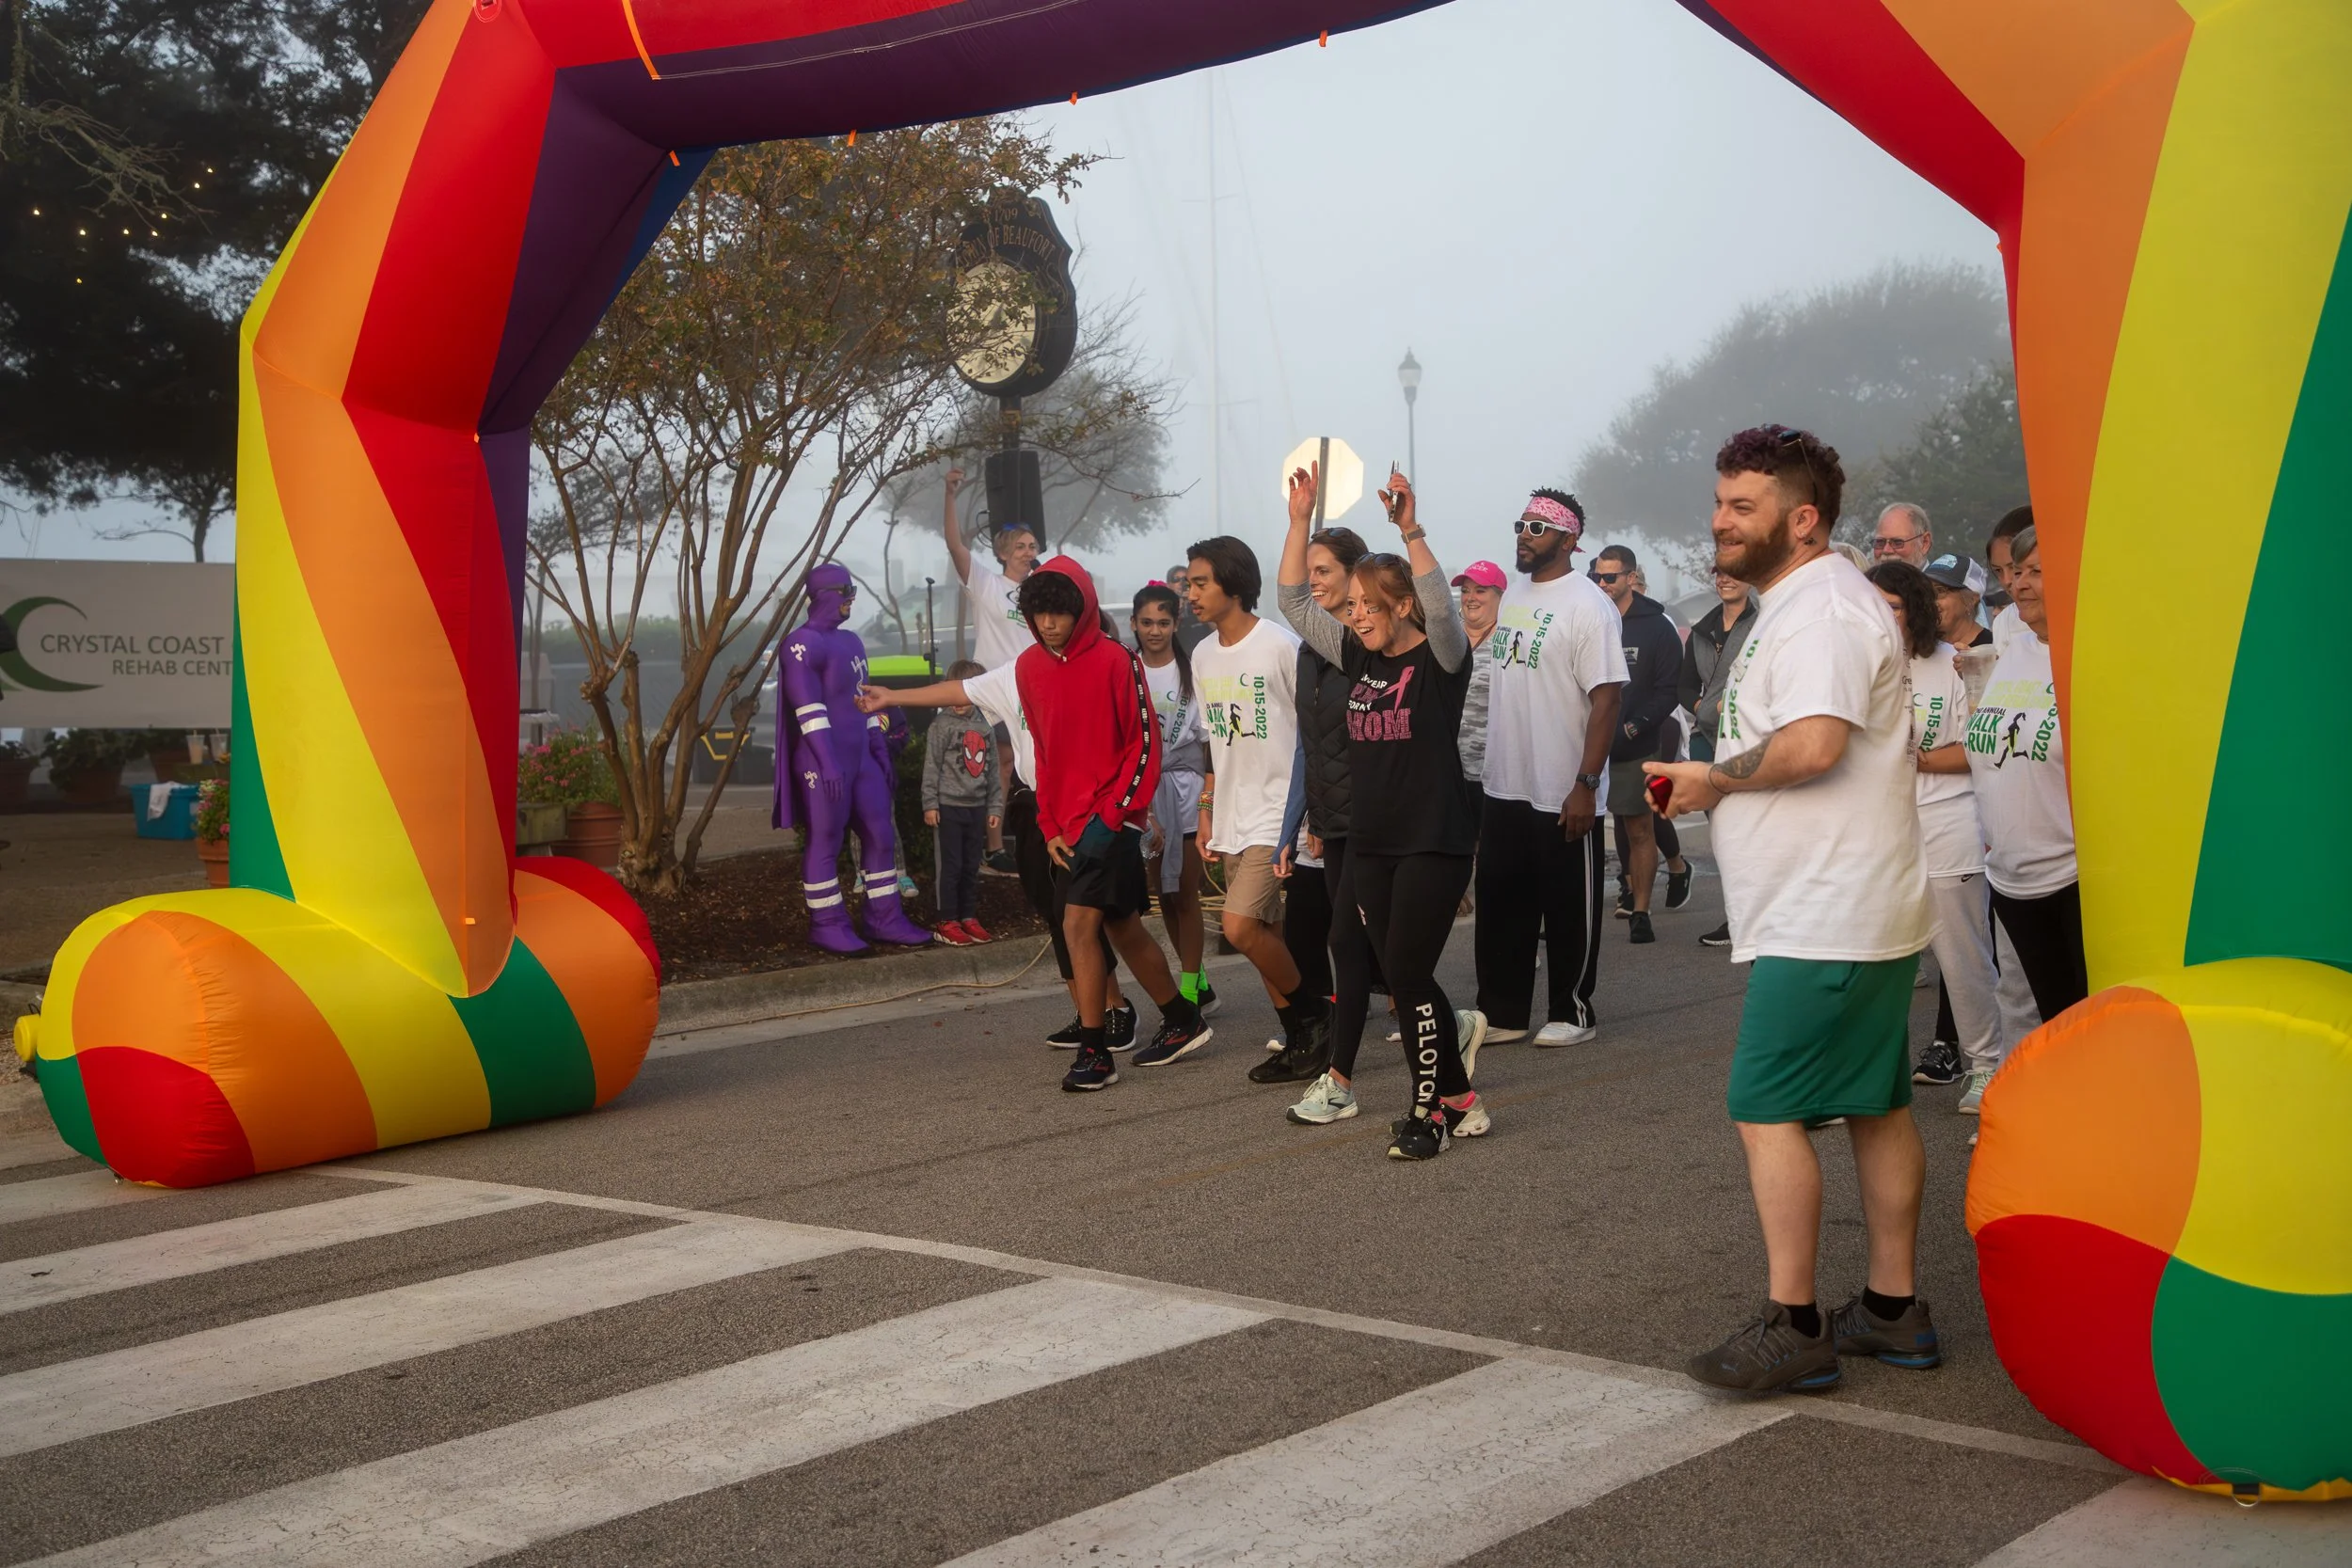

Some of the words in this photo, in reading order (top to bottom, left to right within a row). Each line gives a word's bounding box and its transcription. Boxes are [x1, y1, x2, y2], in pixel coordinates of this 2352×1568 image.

[1003, 225, 1056, 261] BEAUFORT
[40, 634, 140, 655] CRYSTAL
[148, 636, 225, 655] COAST
[1527, 613, 1553, 669] 10-15-2022
[113, 659, 177, 675] REHAB
[1170, 696, 1188, 744] 10-15-2022
[1254, 675, 1267, 739] 10-15-2022
[1346, 708, 1411, 741] MOM
[1416, 1003, 1438, 1102] PELOTON
